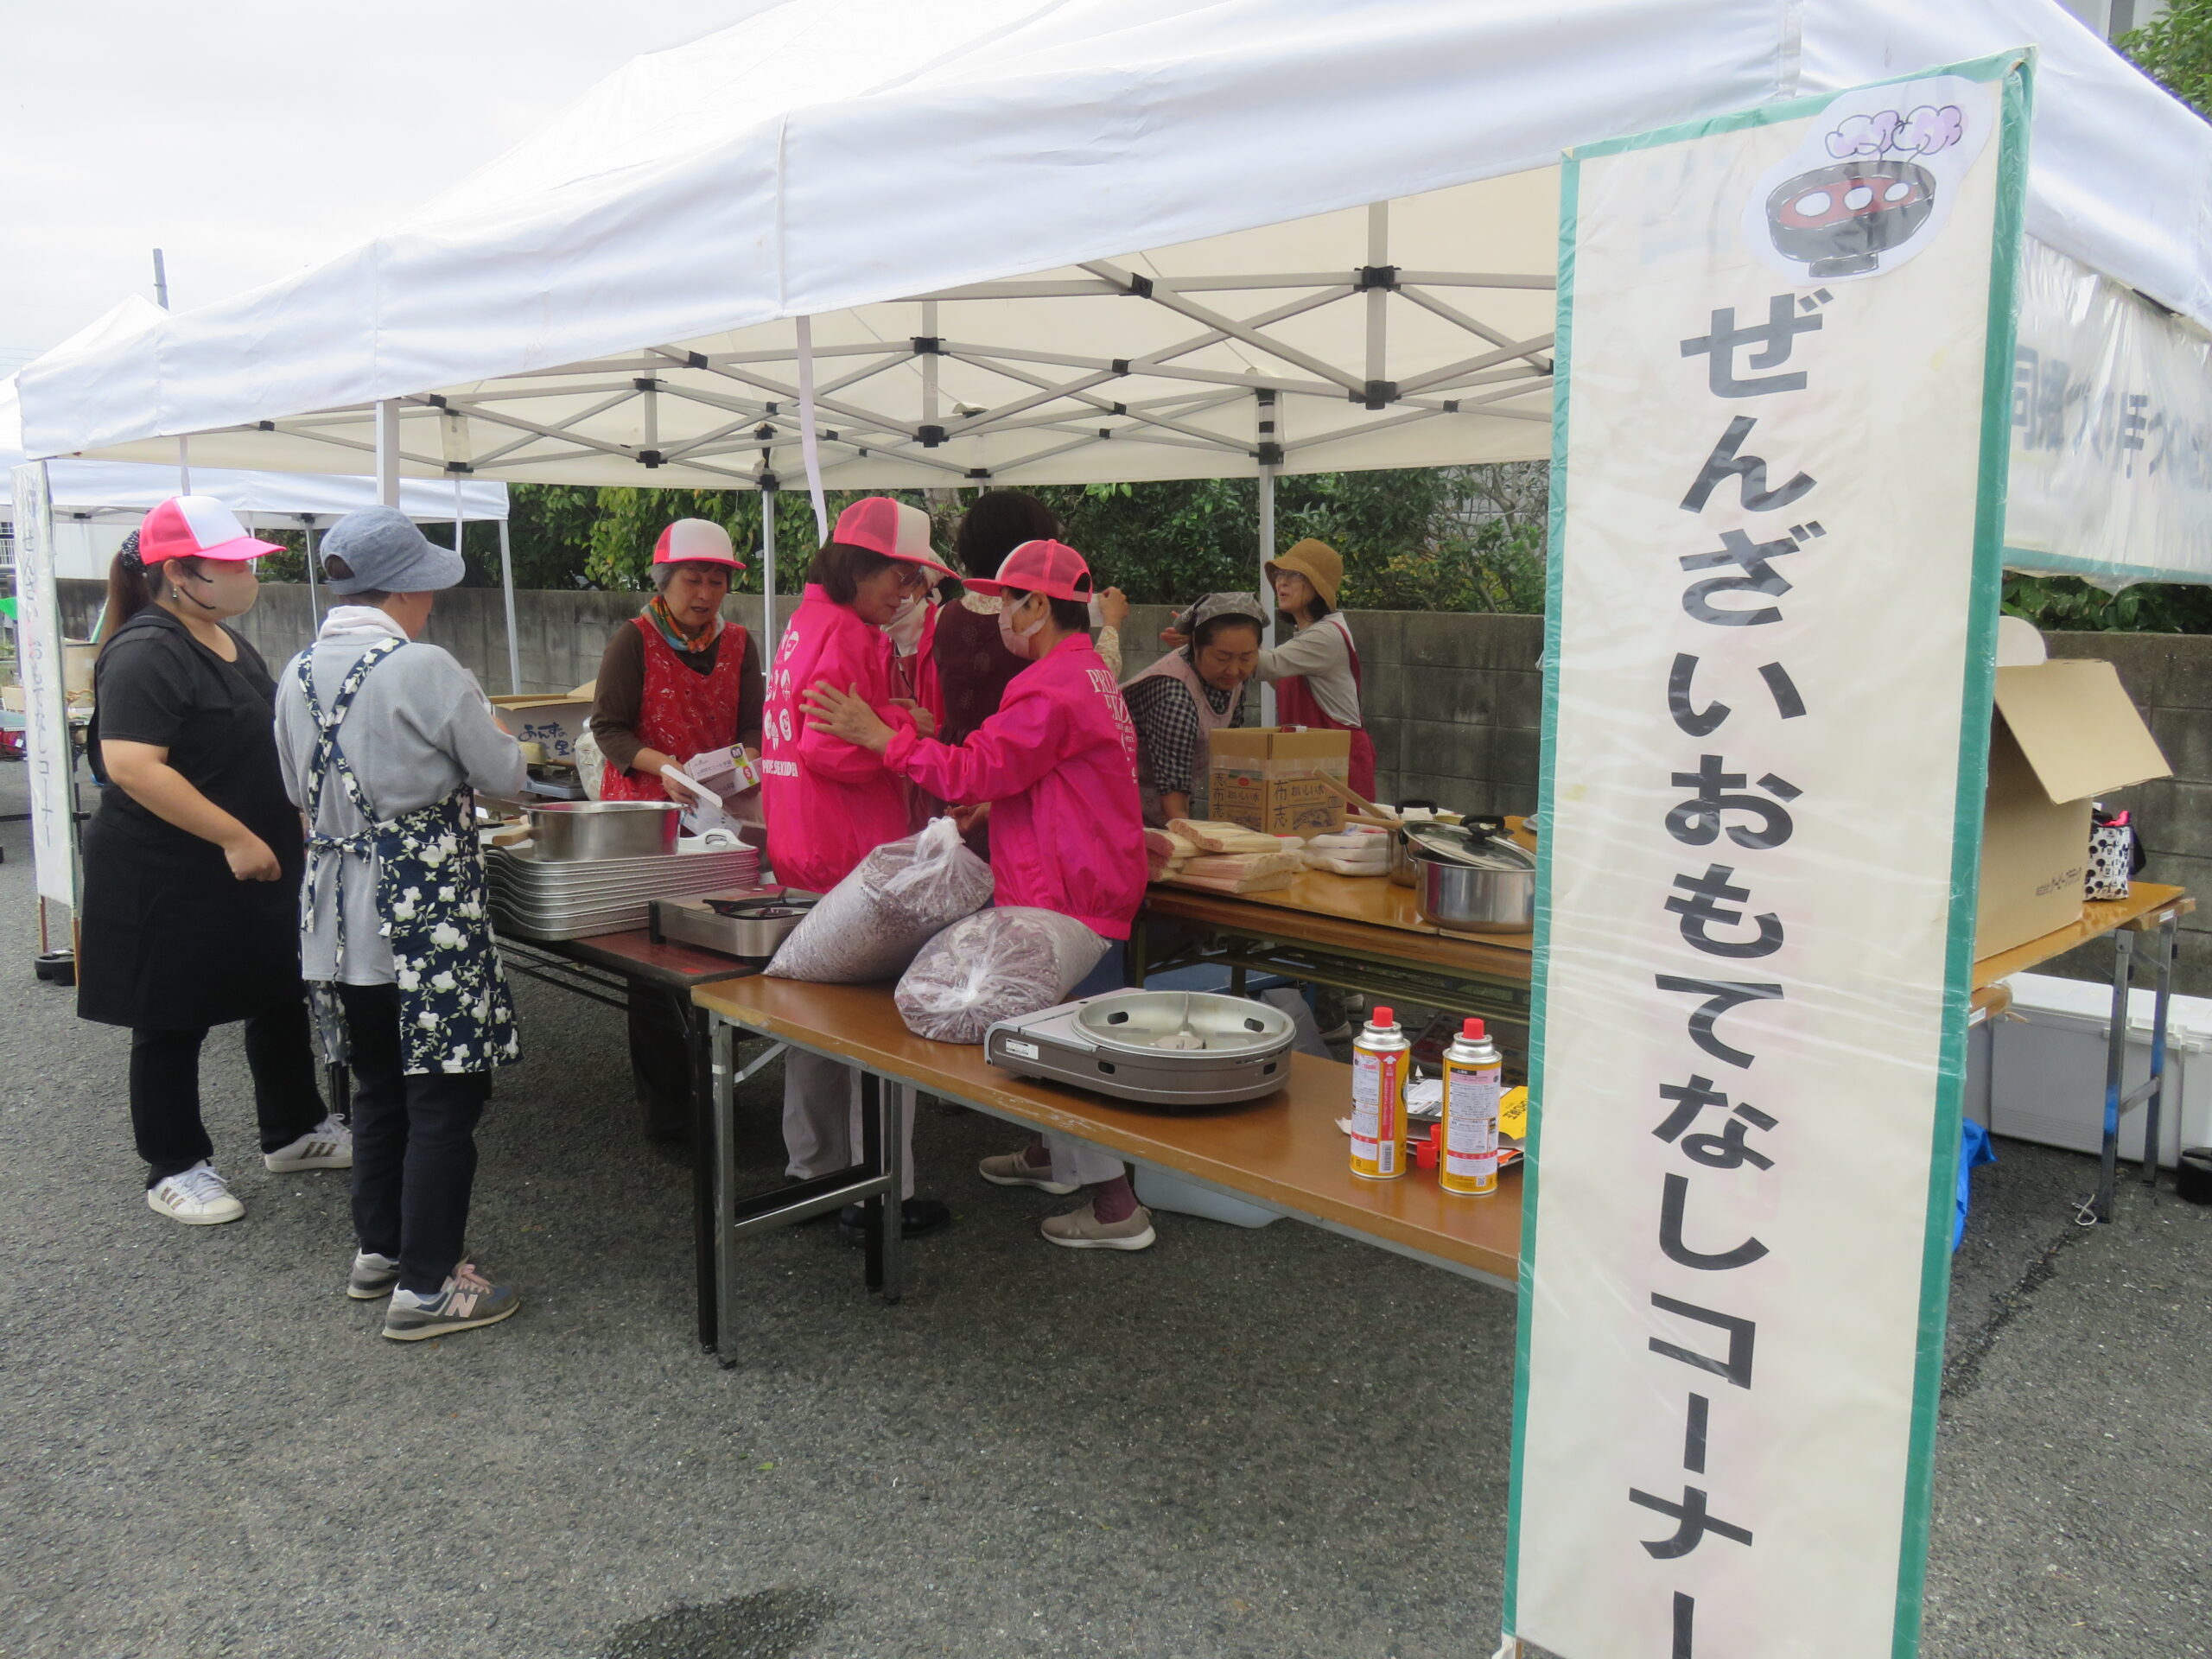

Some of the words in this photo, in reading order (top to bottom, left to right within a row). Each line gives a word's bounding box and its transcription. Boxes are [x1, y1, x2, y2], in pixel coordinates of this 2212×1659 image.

[1273, 779, 1290, 829] 布志
[1629, 287, 1835, 1659] ぜんざいおもてなしコーナー
[444, 1292, 478, 1319] N
